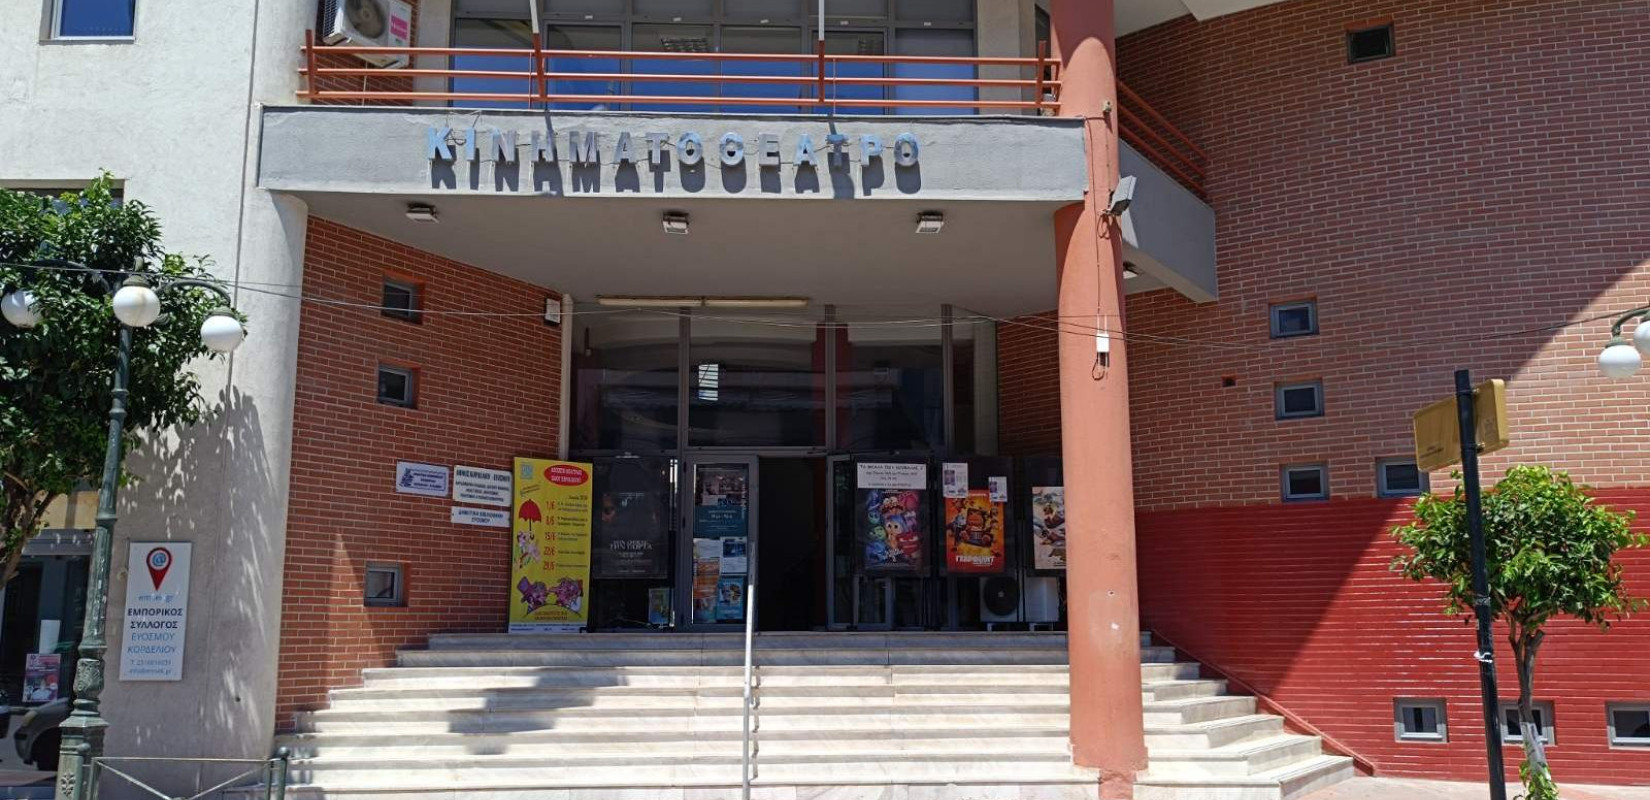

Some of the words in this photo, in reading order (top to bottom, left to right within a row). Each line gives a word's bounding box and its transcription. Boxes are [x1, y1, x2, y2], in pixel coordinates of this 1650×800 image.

[427, 127, 919, 167] ΚΙΝΗΜΑΤΟΘΕΑΤΡΟ
[127, 607, 183, 617] ΕΜΠΟΡΙΚΟΣ
[130, 620, 178, 629] ΣΥΛΛΟΓΟΣ
[131, 632, 176, 642] ΕΥΟΣΜΟΥ
[127, 645, 177, 654] ΚΟΡΔΕΛΙΟΥ
